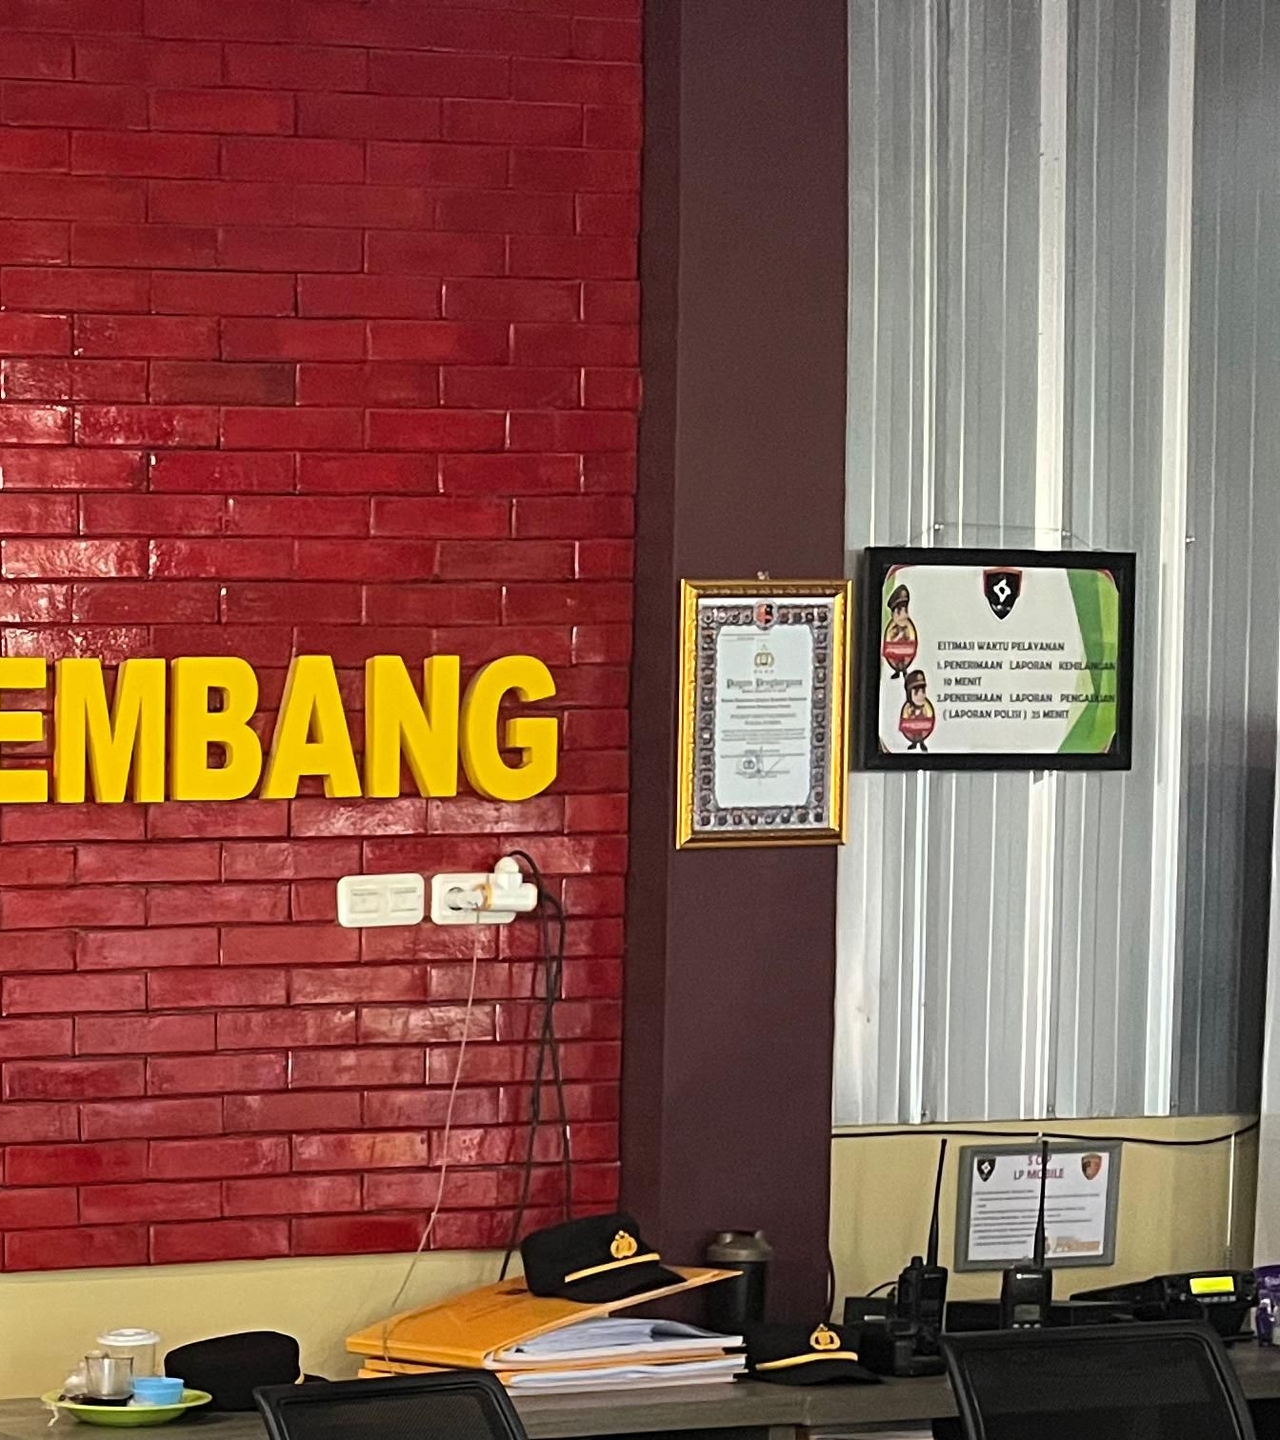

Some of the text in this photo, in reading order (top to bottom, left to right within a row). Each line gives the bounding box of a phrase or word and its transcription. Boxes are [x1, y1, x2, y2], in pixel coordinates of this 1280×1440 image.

[977, 641, 1009, 651] WAKTU
[1011, 641, 1065, 651] PELAYANAN
[1009, 660, 1052, 670] LAPORAN
[943, 676, 982, 686] 10 MENIT
[1010, 693, 1053, 703] LAPORAN
[1042, 710, 1070, 719] MENIT
